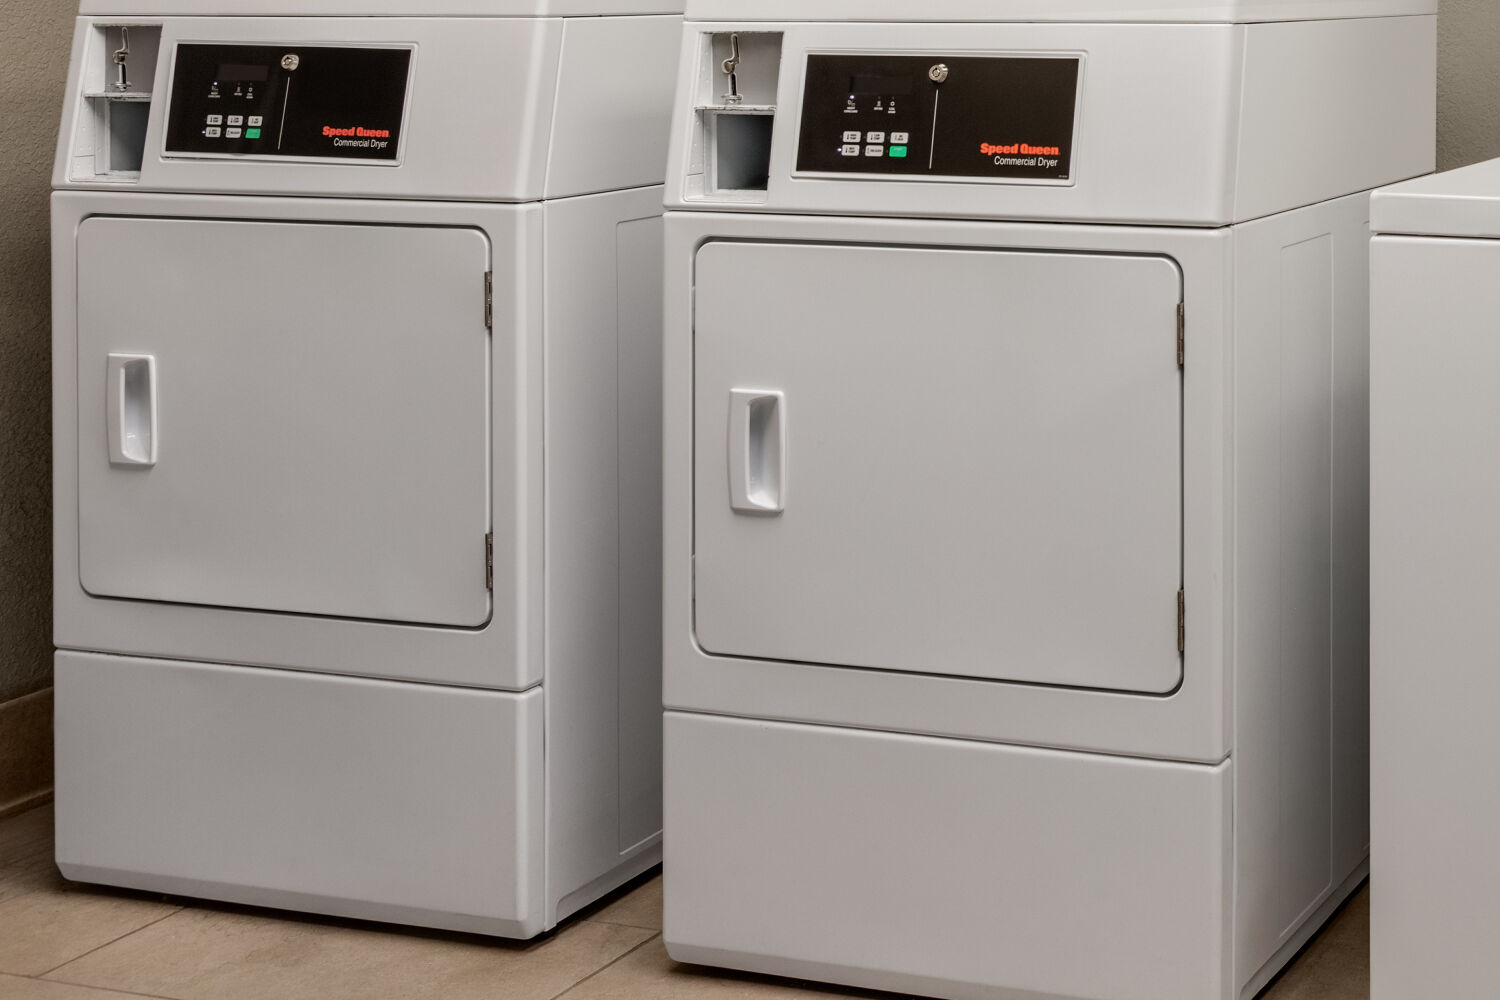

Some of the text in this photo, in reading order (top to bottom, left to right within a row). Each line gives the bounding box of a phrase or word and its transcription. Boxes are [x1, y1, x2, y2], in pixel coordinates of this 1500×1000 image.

[322, 125, 390, 138] Speed Queen
[333, 138, 388, 150] Commercial Dryer
[980, 142, 1059, 156] Speed Queen
[994, 155, 1058, 169] Commercial Dryer
